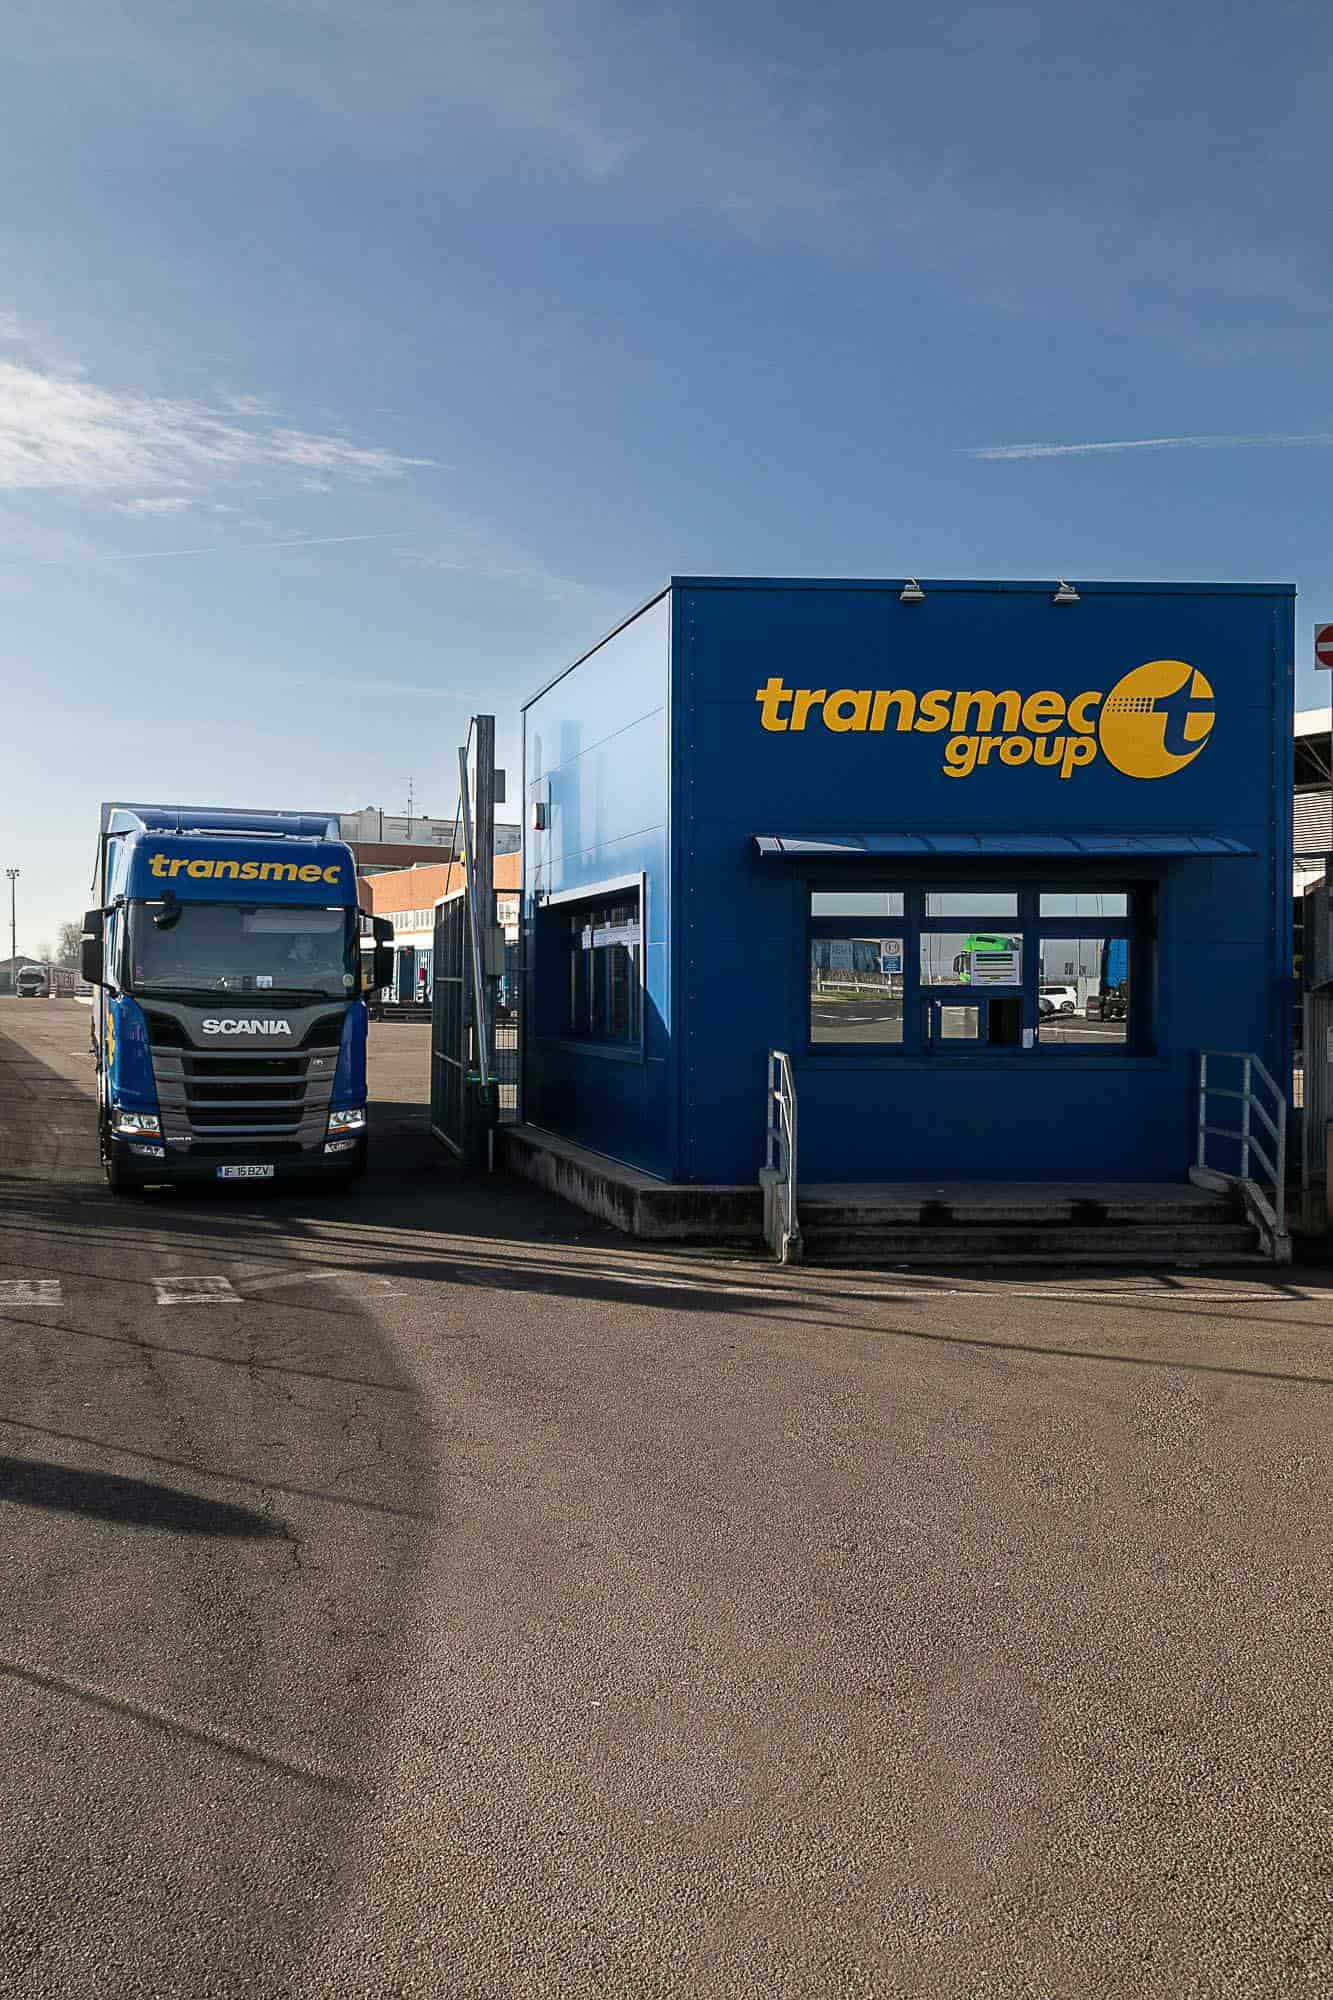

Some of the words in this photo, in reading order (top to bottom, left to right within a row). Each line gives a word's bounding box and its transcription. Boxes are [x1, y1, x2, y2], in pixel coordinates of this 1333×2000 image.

[755, 677, 1103, 733] transmec
[943, 734, 1097, 779] group
[148, 853, 342, 884] transmec
[202, 1019, 292, 1034] SCANIA
